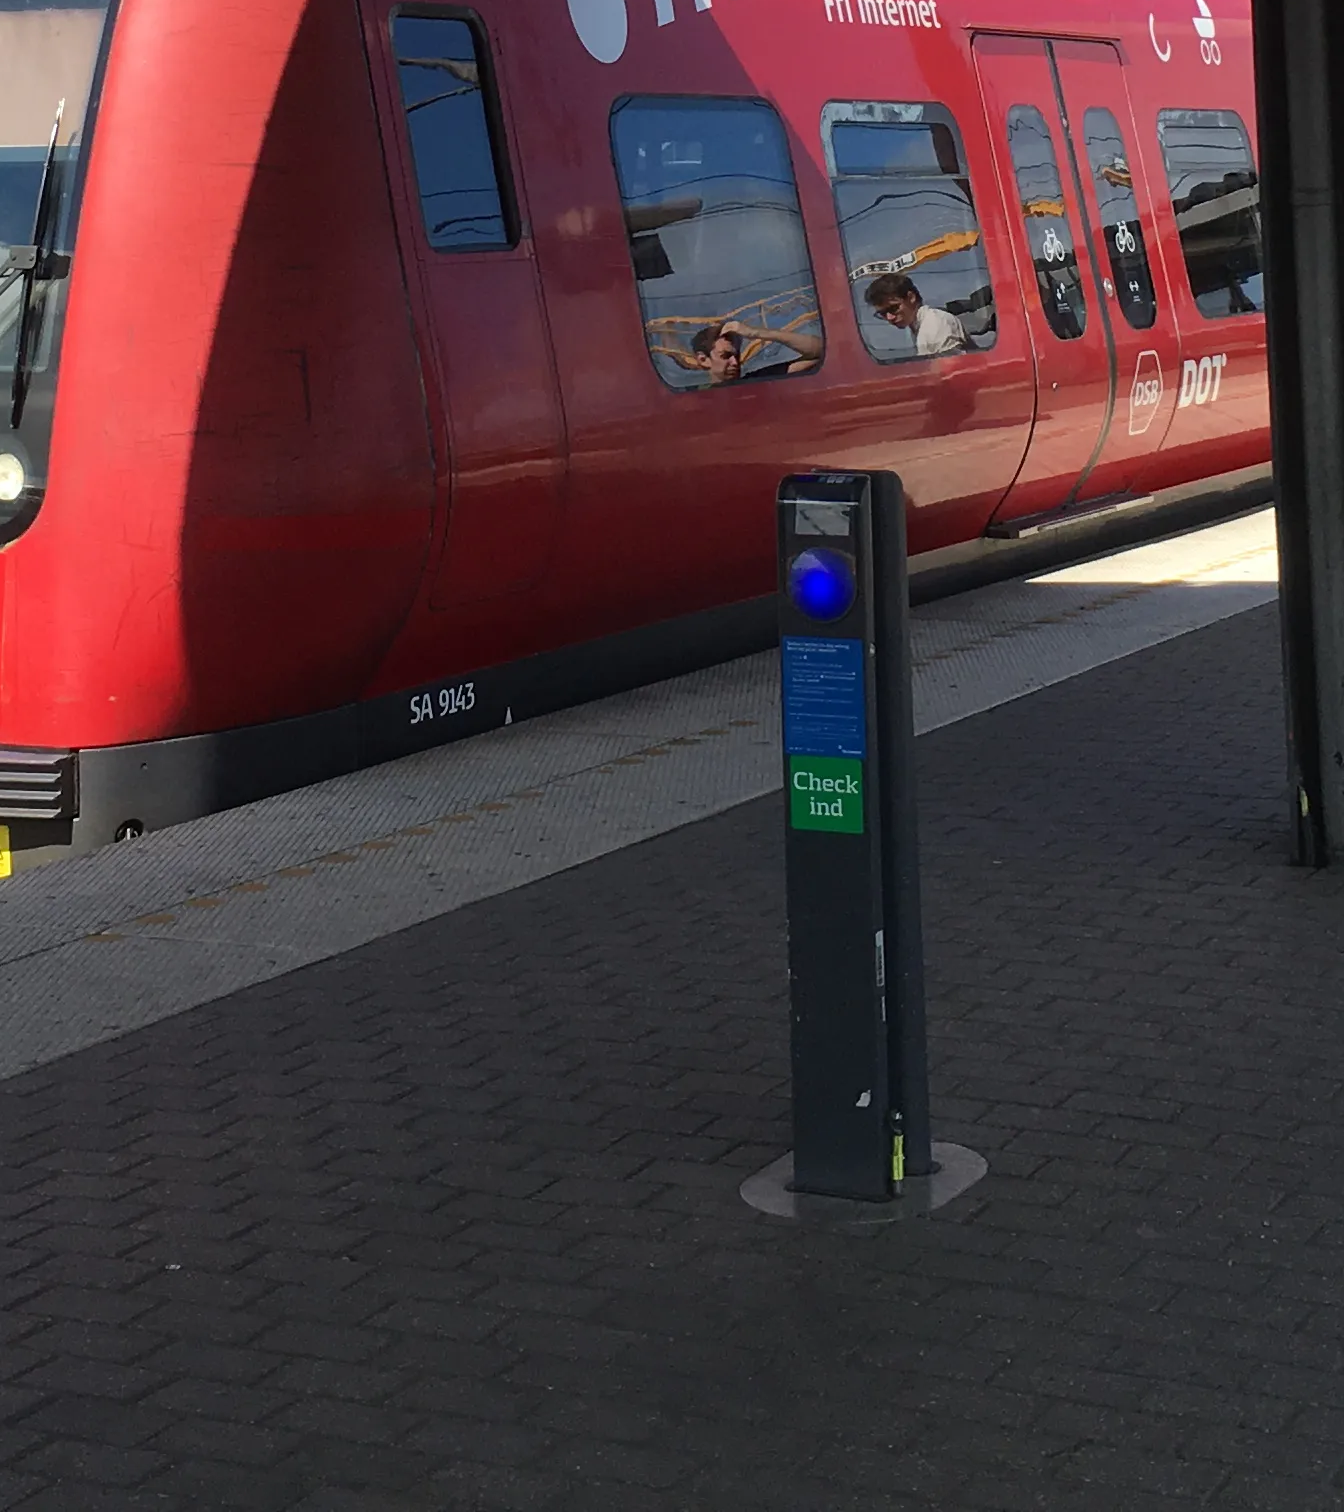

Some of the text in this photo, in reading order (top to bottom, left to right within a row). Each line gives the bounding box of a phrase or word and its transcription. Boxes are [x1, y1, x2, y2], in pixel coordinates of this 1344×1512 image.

[1133, 380, 1159, 407] DSB
[409, 682, 476, 725] SA 9143
[792, 771, 860, 796] Check
[808, 795, 844, 819] ind
